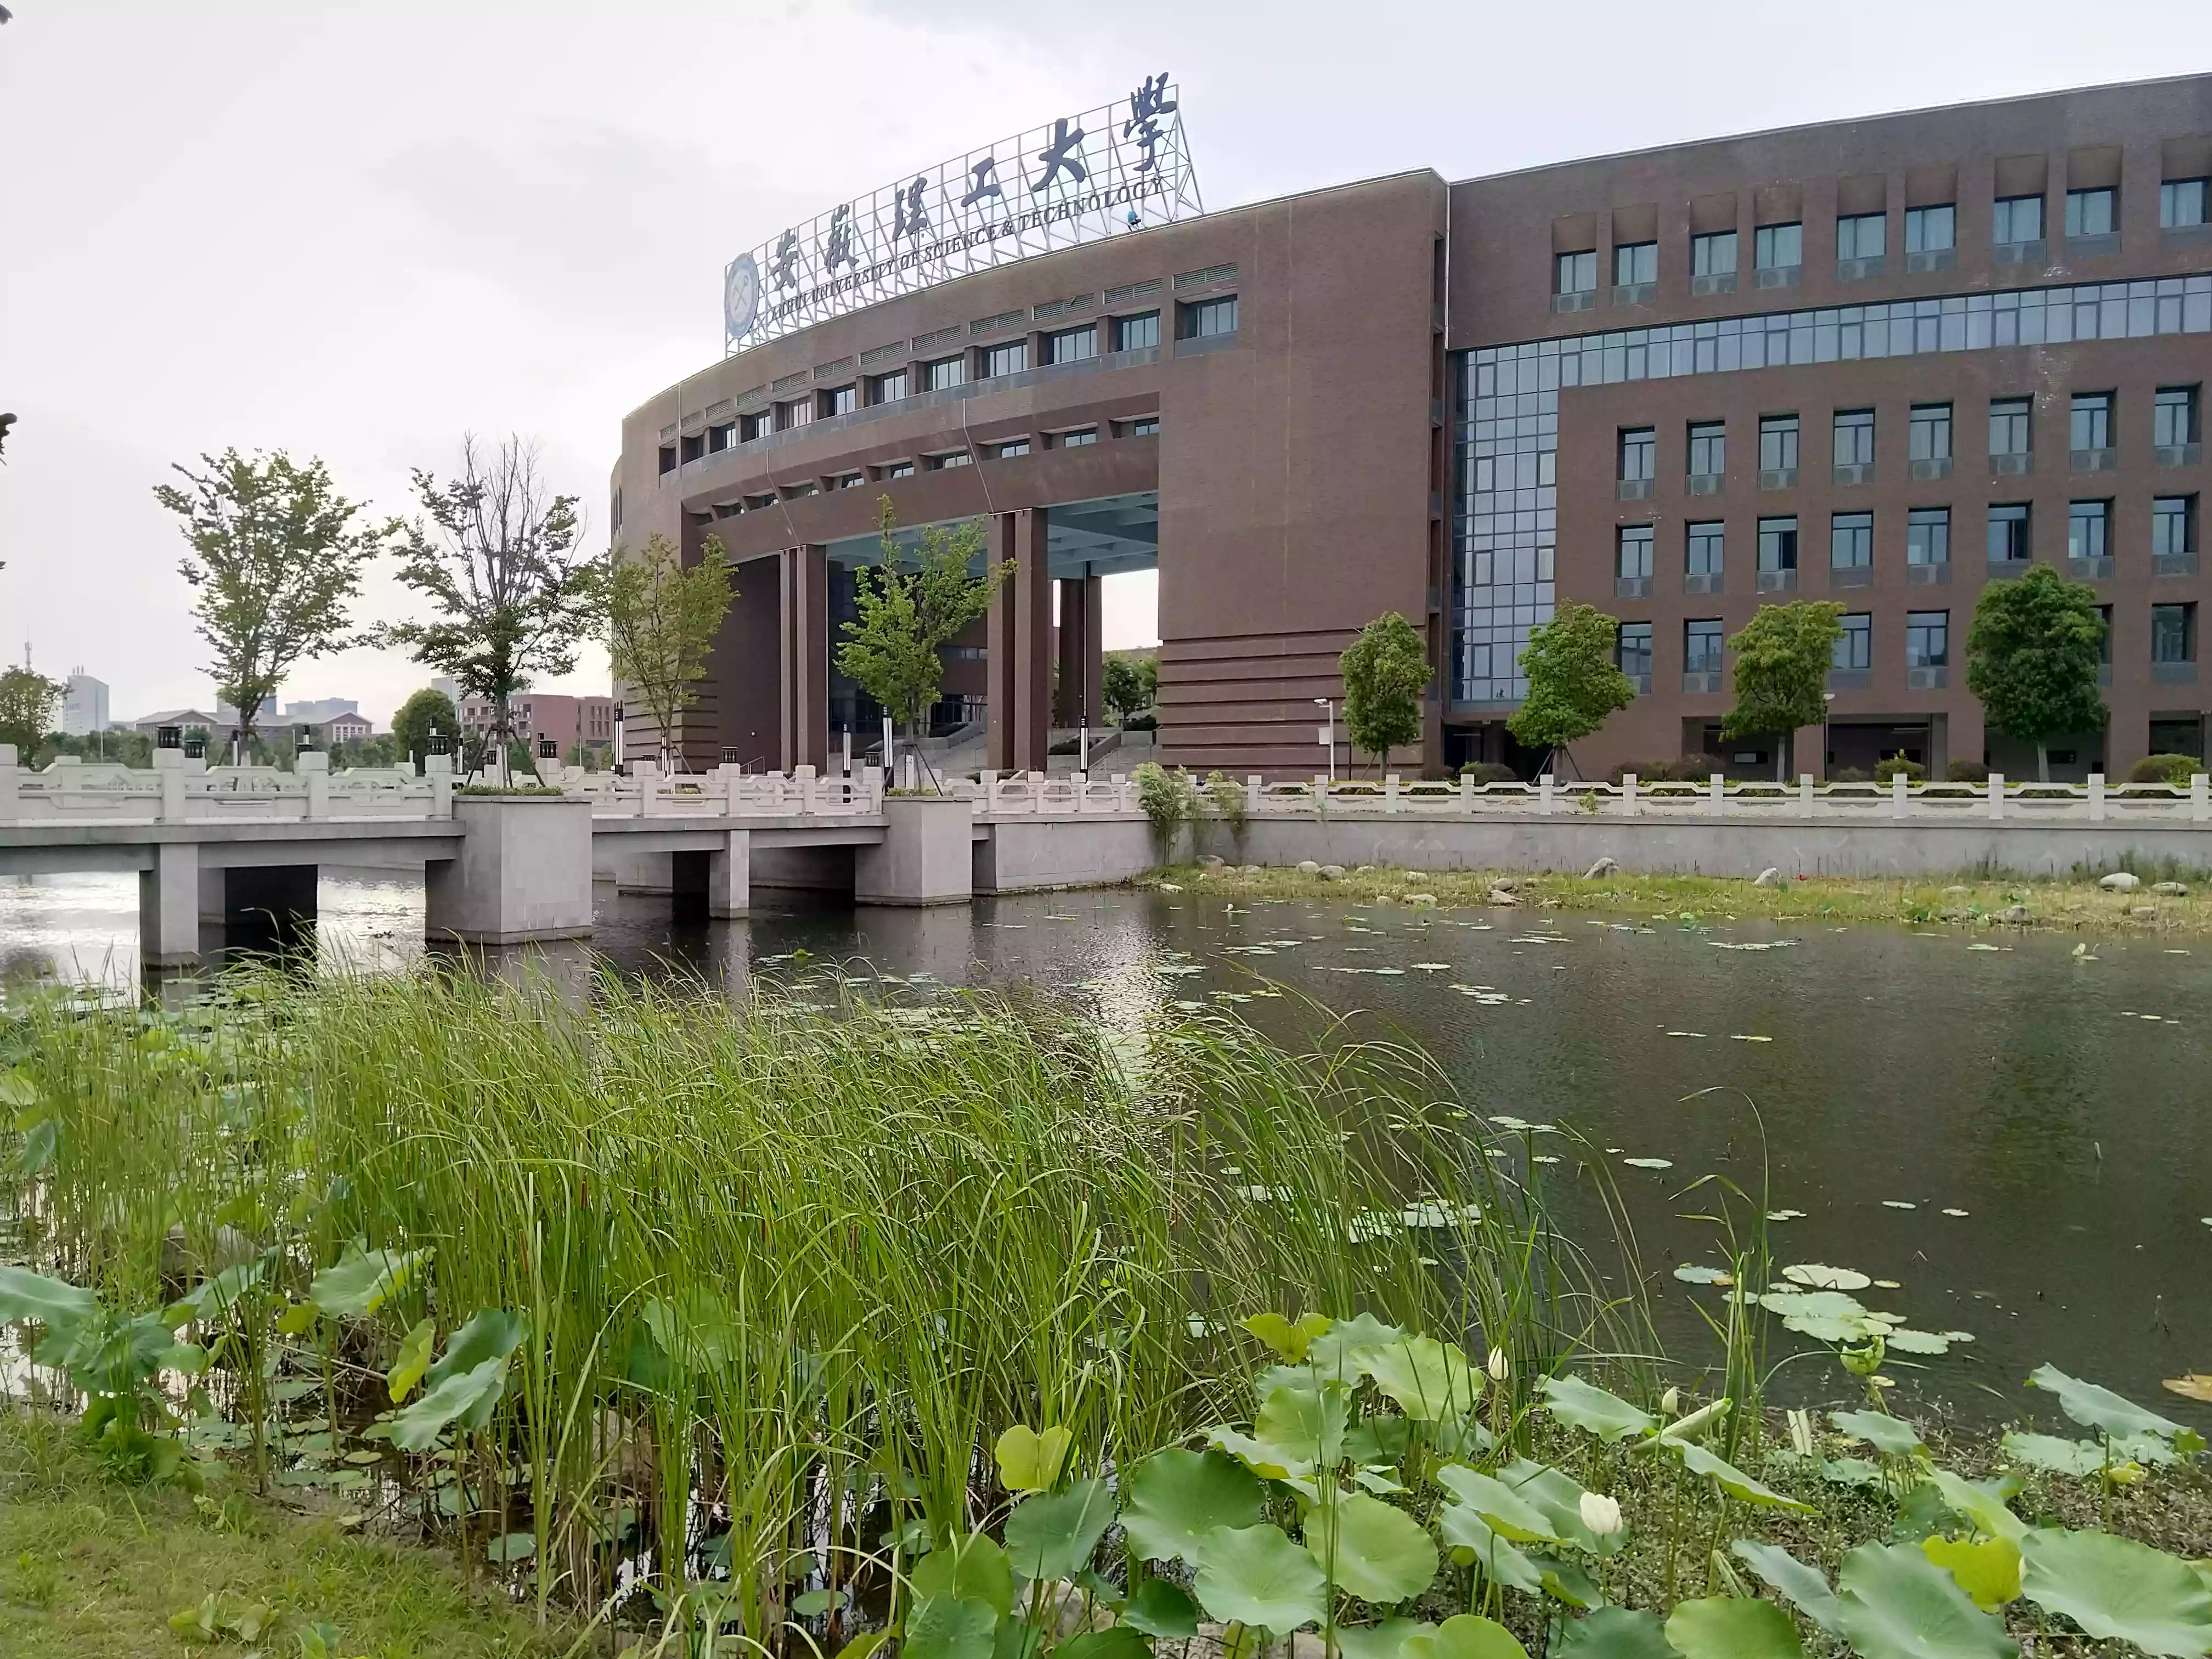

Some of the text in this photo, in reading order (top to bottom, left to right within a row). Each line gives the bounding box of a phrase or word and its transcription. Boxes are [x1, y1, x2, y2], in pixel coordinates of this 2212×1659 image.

[811, 260, 895, 302] UNIVERSITY
[900, 250, 919, 269] OF
[924, 224, 997, 262] SCIENCE
[1002, 219, 1015, 236] &
[1018, 176, 1164, 230] TECHNOLOGY
